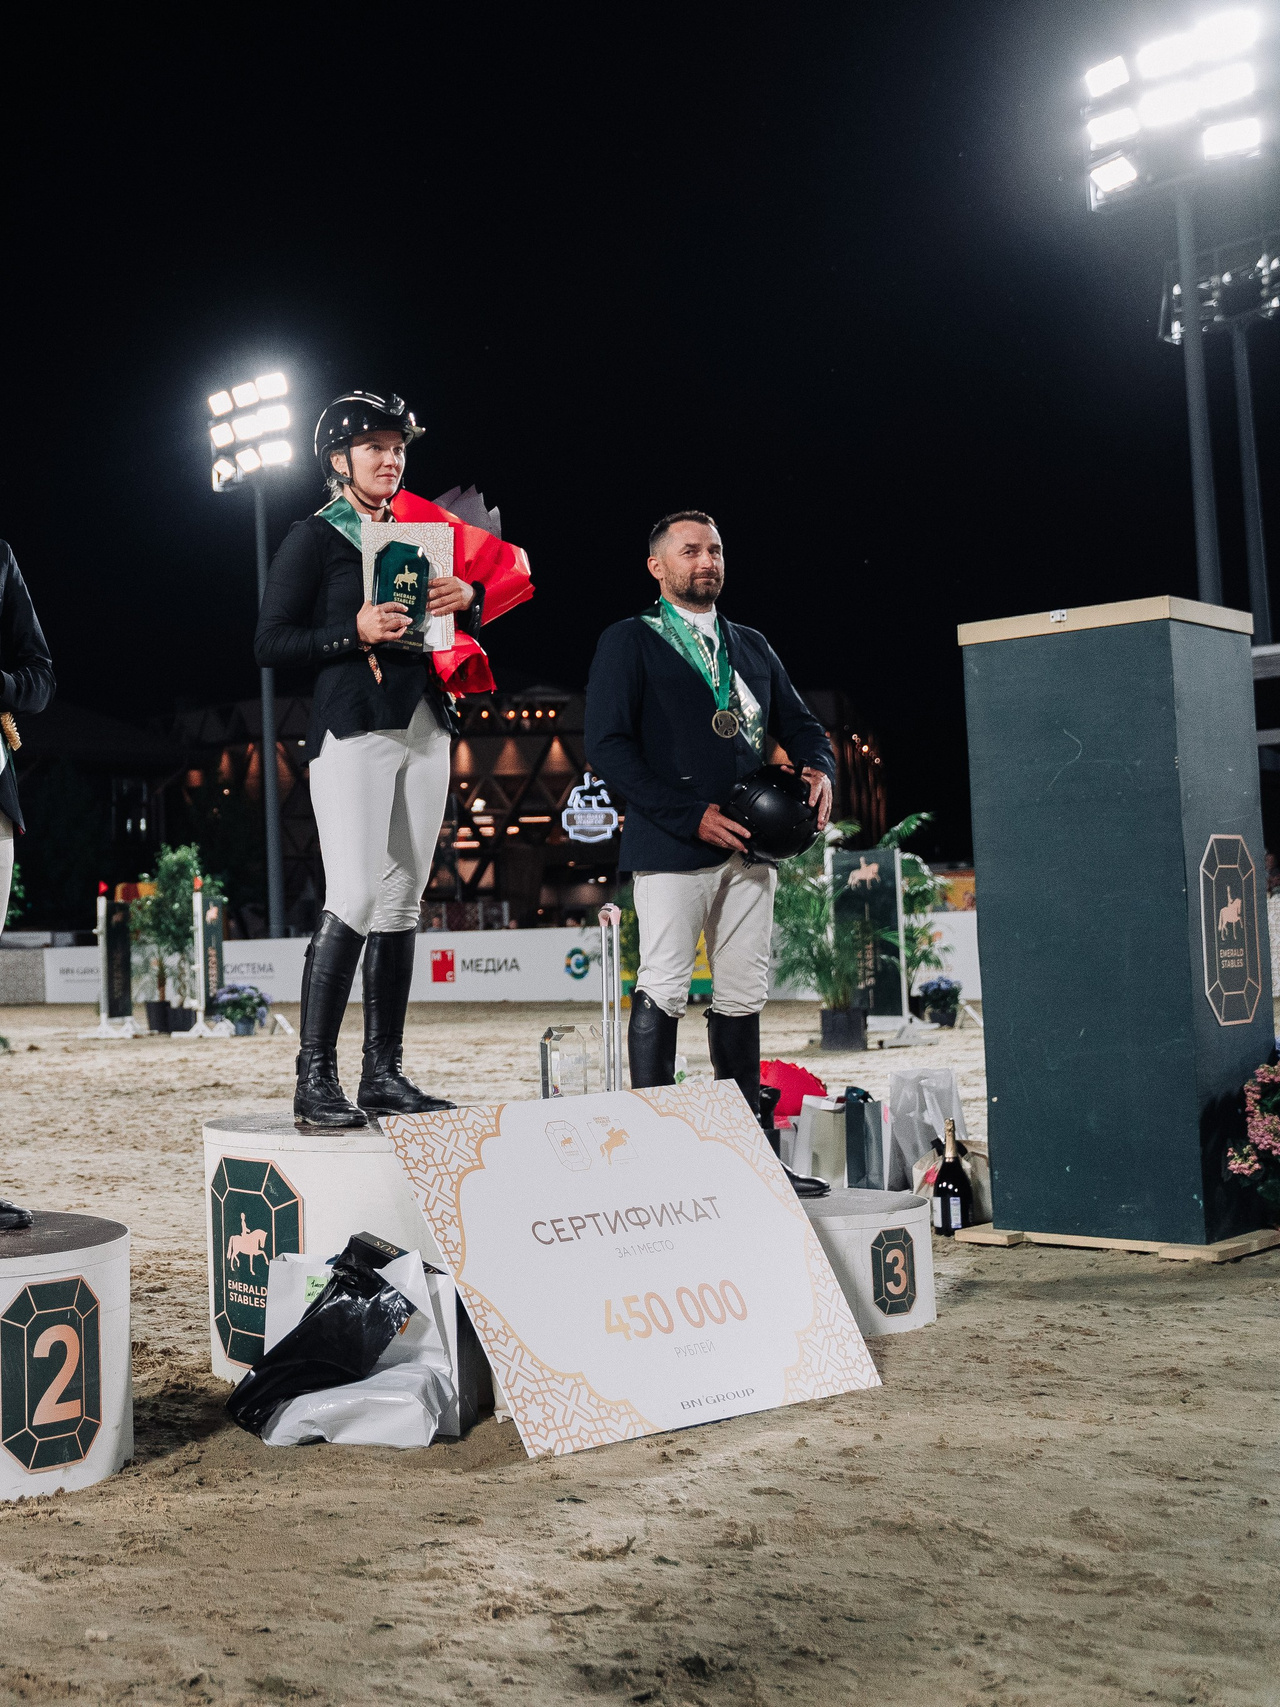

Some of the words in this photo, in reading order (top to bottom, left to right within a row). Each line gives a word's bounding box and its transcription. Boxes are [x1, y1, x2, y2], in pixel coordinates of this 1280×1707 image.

[1220, 949, 1244, 958] EMERALD
[461, 957, 520, 974] МЕДИА
[1221, 959, 1244, 968] STABLES
[531, 1196, 721, 1246] СЕРТИФИКАТ
[615, 1247, 631, 1258] ЗА
[630, 1245, 637, 1255] 1
[637, 1239, 675, 1255] МЕСТО
[885, 1248, 907, 1295] 3
[227, 1279, 268, 1297] EMERALD
[229, 1291, 266, 1308] STABLES
[605, 1291, 674, 1341] 450
[675, 1279, 748, 1329] 000
[674, 1339, 716, 1358] РУБЛЕЙ
[32, 1324, 81, 1426] 2
